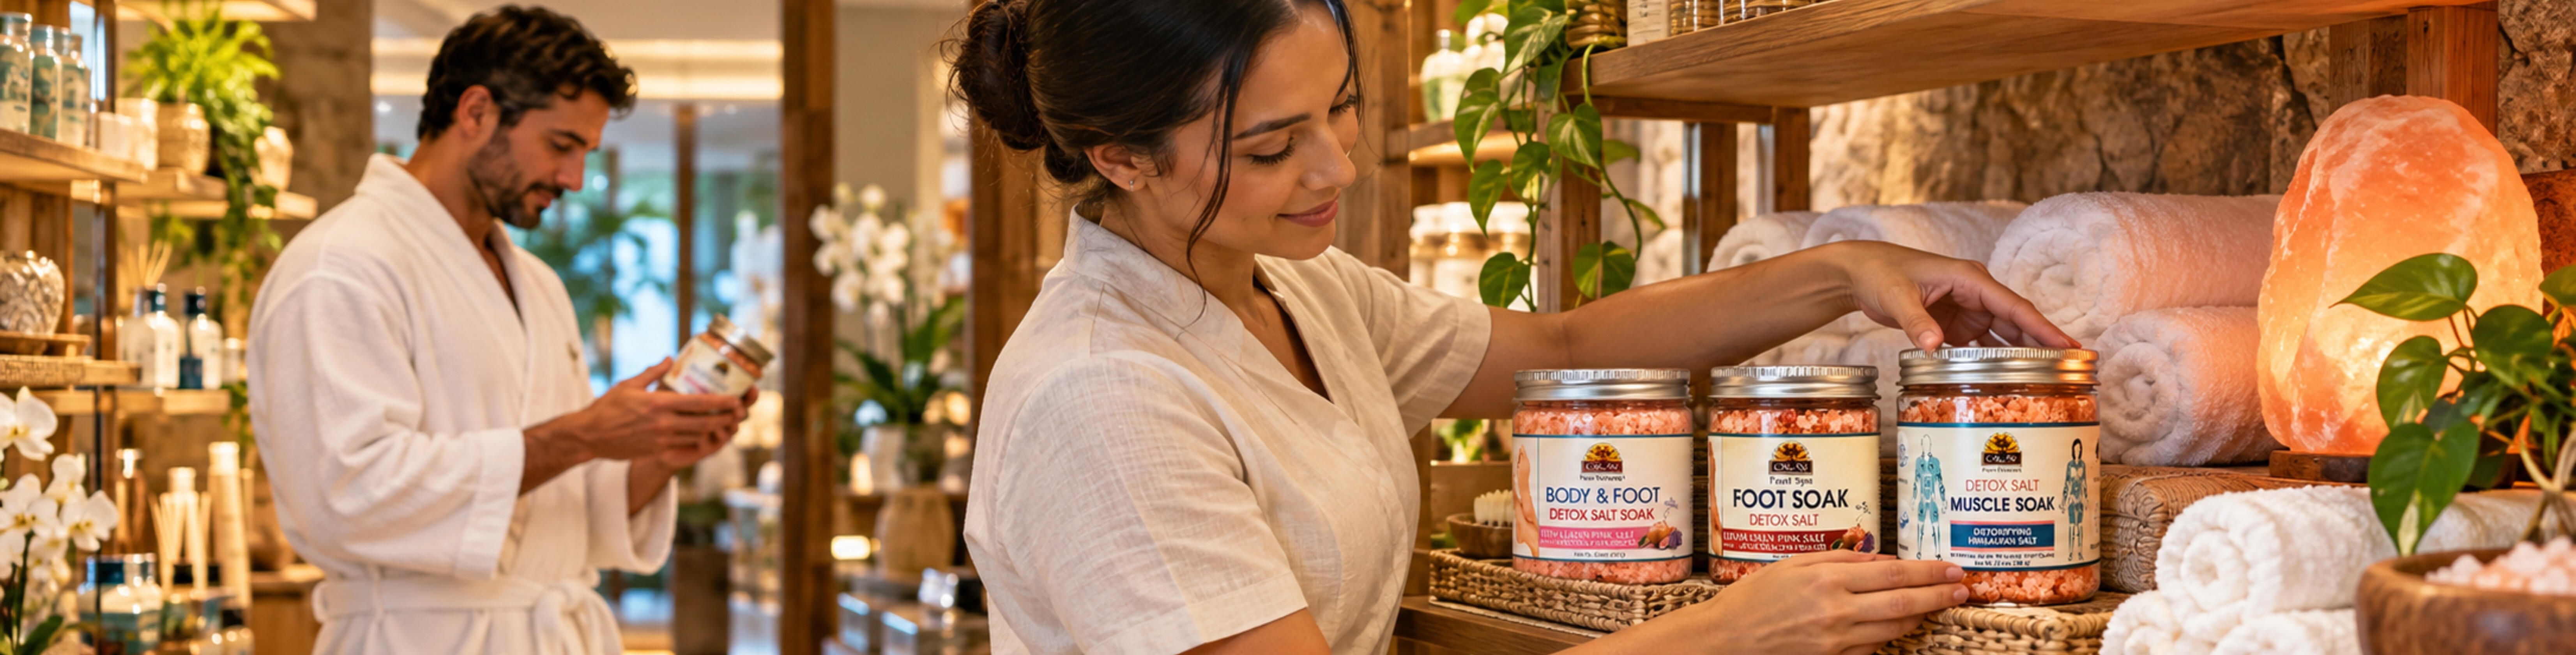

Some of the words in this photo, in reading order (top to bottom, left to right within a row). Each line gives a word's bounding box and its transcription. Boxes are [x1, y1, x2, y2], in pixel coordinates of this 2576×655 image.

[1966, 479, 2007, 492] DETOX
[2011, 479, 2039, 492] SALT
[1546, 487, 1590, 503] BODY
[1597, 488, 1609, 503] &
[1614, 487, 1660, 504] FOOT
[1733, 489, 1786, 508] FOOT
[1793, 489, 1848, 508] SOAK
[1950, 497, 2010, 512] MUSCLE
[2016, 496, 2054, 512] SOAK
[1550, 508, 1587, 520] DETOX
[1591, 509, 1617, 520] SALT
[1620, 508, 1654, 520] SOAK
[1750, 513, 1788, 526] DETOX
[1792, 514, 1818, 526] SALT
